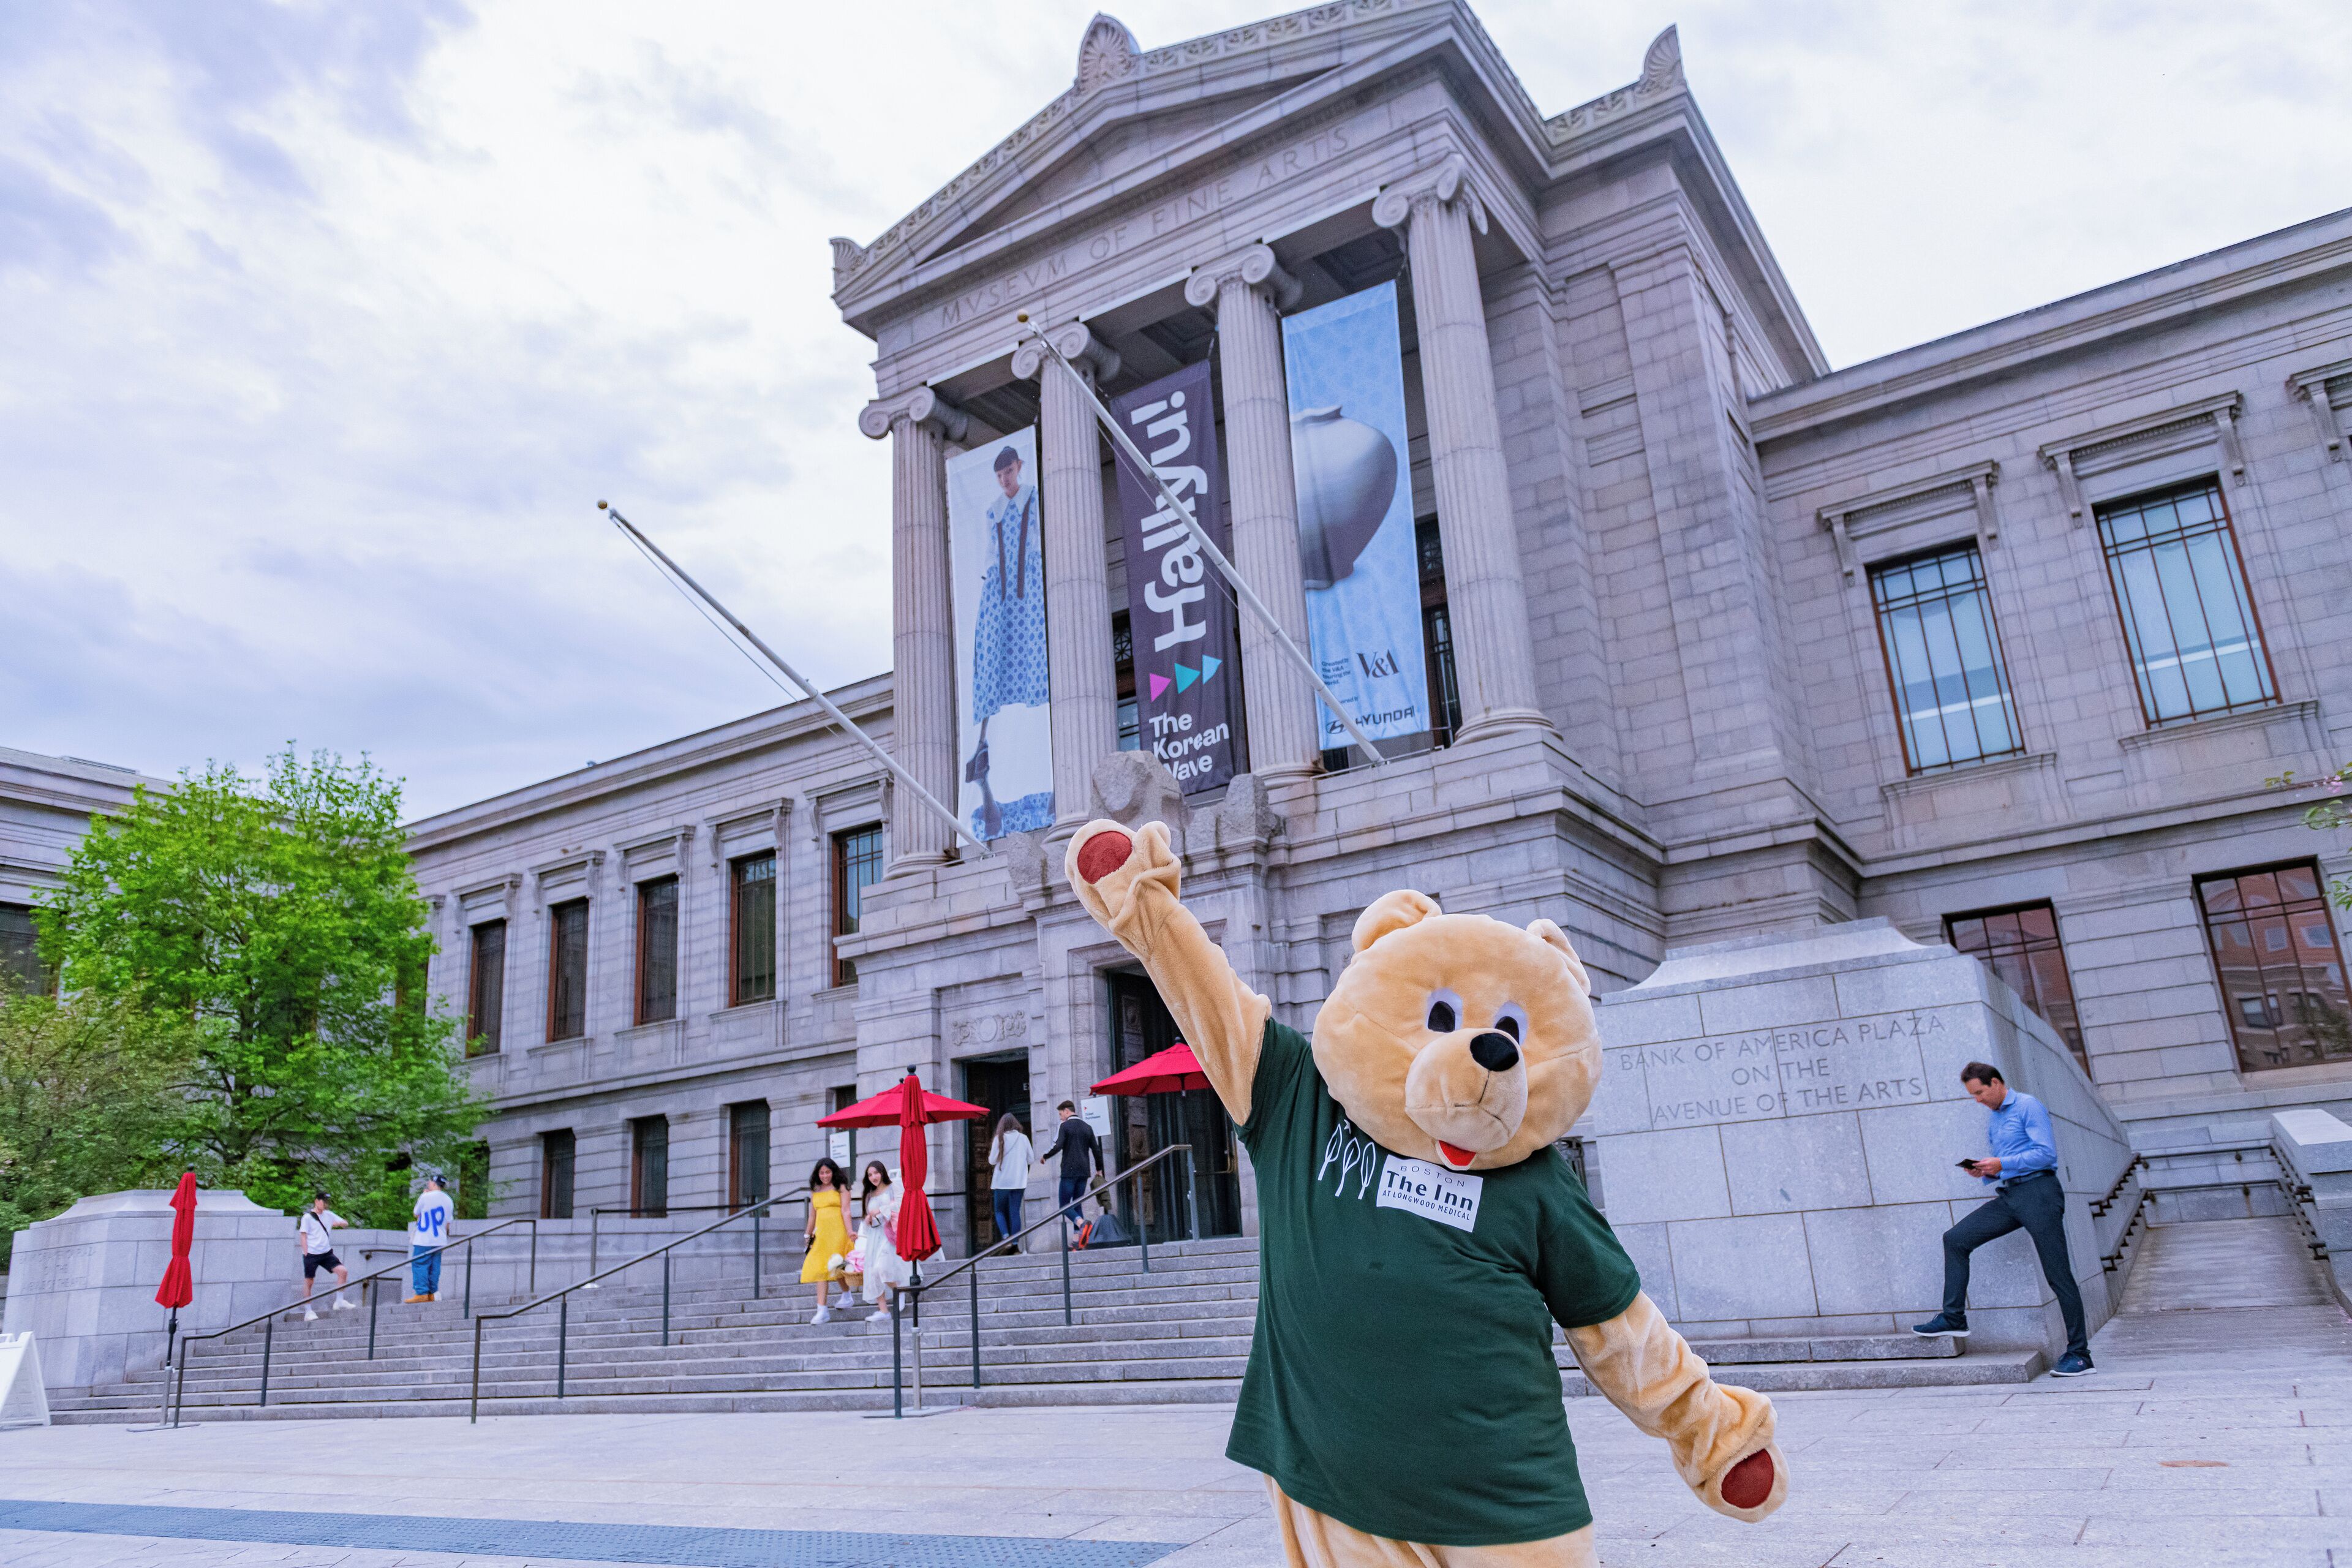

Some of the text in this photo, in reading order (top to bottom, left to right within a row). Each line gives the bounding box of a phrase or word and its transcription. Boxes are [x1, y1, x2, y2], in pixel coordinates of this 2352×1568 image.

[942, 126, 1348, 328] MVSEVM OF FINE ARTS
[1356, 649, 1400, 679] V&A
[1149, 712, 1193, 738] The
[1153, 723, 1229, 760] Korean
[1620, 1015, 1947, 1071] BANK OF AMERICA PLAZA
[1732, 1058, 1831, 1085] ON THE
[1654, 1077, 1922, 1124] AVENUE OF THE ARTS
[1387, 1170, 1473, 1212] The Inn
[1400, 1166, 1464, 1187] BOSTON
[1393, 1192, 1435, 1210] LONGWOOD
[1438, 1205, 1470, 1221] MEDICAL
